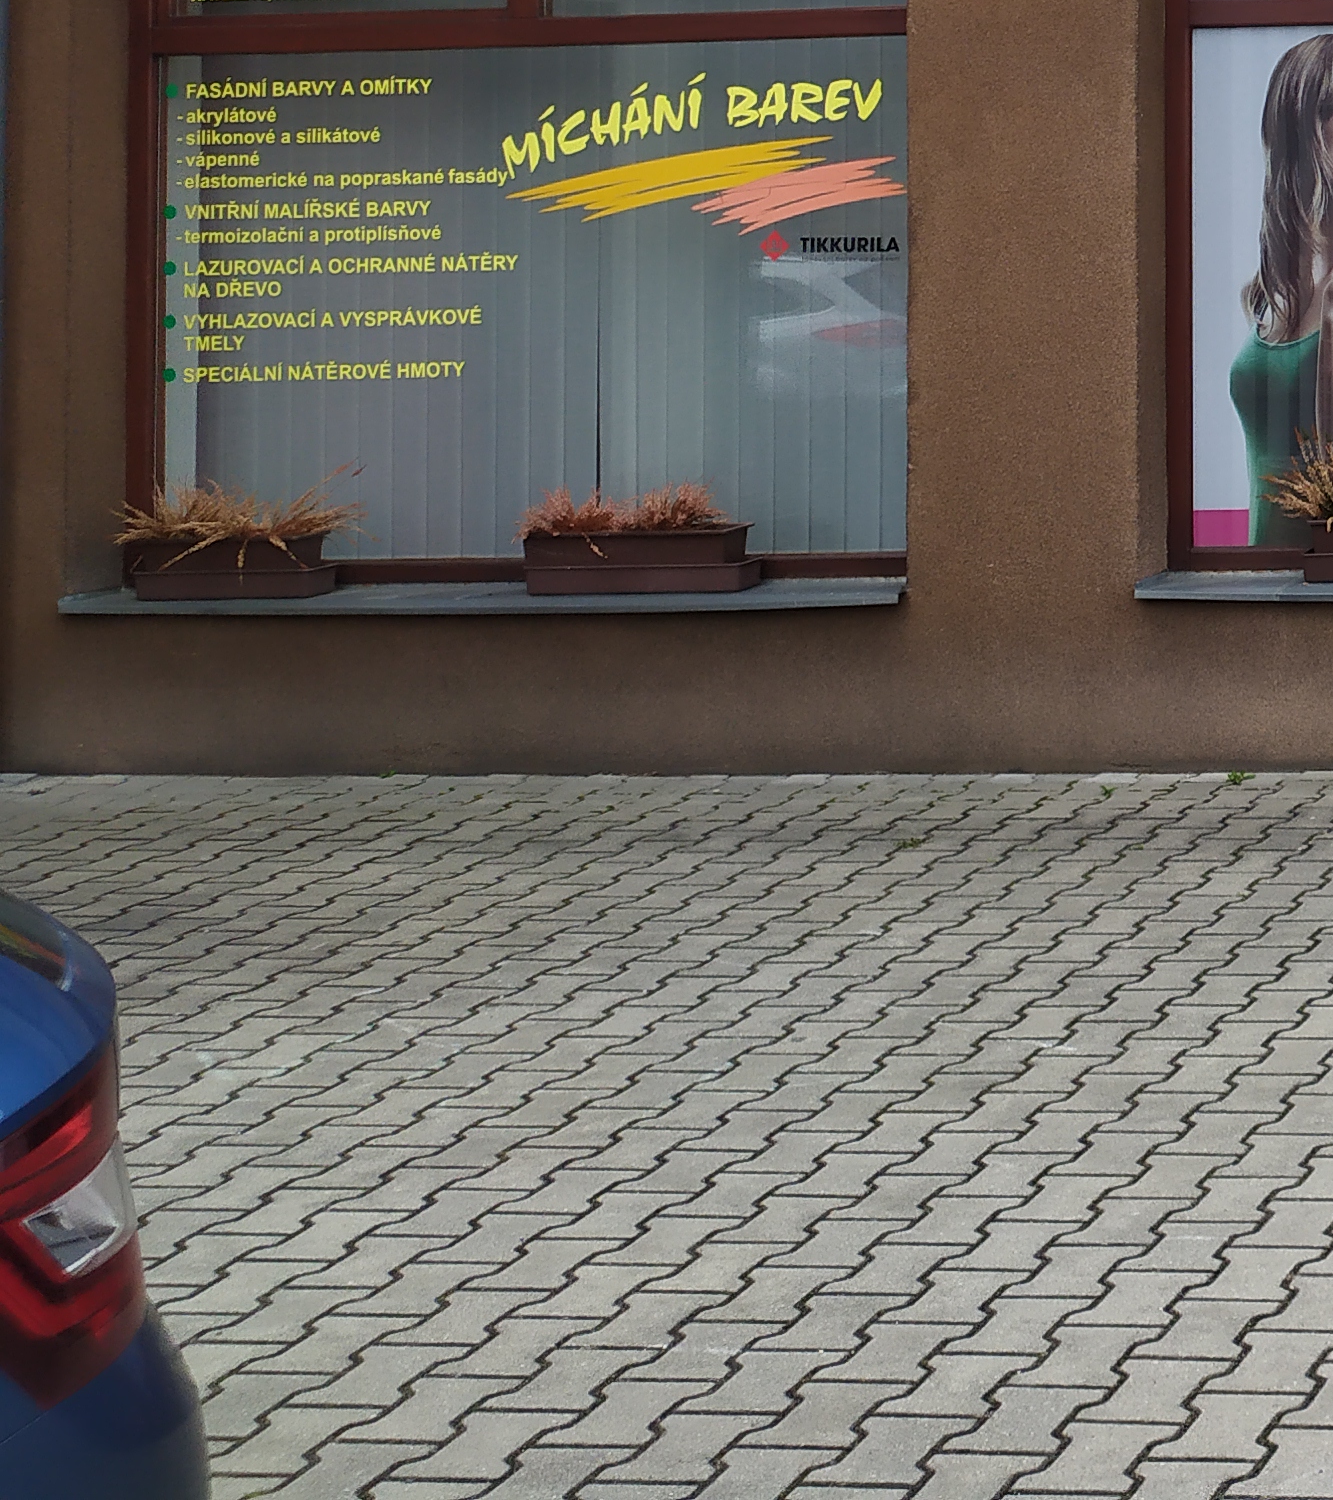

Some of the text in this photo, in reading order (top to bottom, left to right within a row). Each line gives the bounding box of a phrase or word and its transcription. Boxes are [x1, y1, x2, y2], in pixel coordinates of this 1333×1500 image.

[187, 75, 432, 99] FASÁDNÍ BARVY A OMÍTKY
[281, 133, 290, 144] a
[297, 128, 380, 144] silikátové
[501, 73, 882, 180] MÍCHÁNÍ BAREV
[314, 175, 335, 187] na
[341, 169, 444, 188] popraskané
[449, 168, 508, 187] fasády
[185, 198, 431, 220] VNITŘNÍ MALÍŘSKÉ BARVY
[310, 231, 319, 242] a
[325, 225, 441, 245] protiplísňové
[800, 237, 899, 252] TIKKURILA
[184, 252, 518, 277] LAZUROVACÍ A OCHRANNÉ NÁTĚRY
[184, 278, 282, 298] NA DŘEVO
[184, 305, 482, 331] VYHLAZOVACÍ A VYSPRÁVKOVÉ
[184, 336, 245, 352] TMELY
[183, 359, 465, 383] SPECIÁLNÍ NÁTĚROVÉ HMOTY
